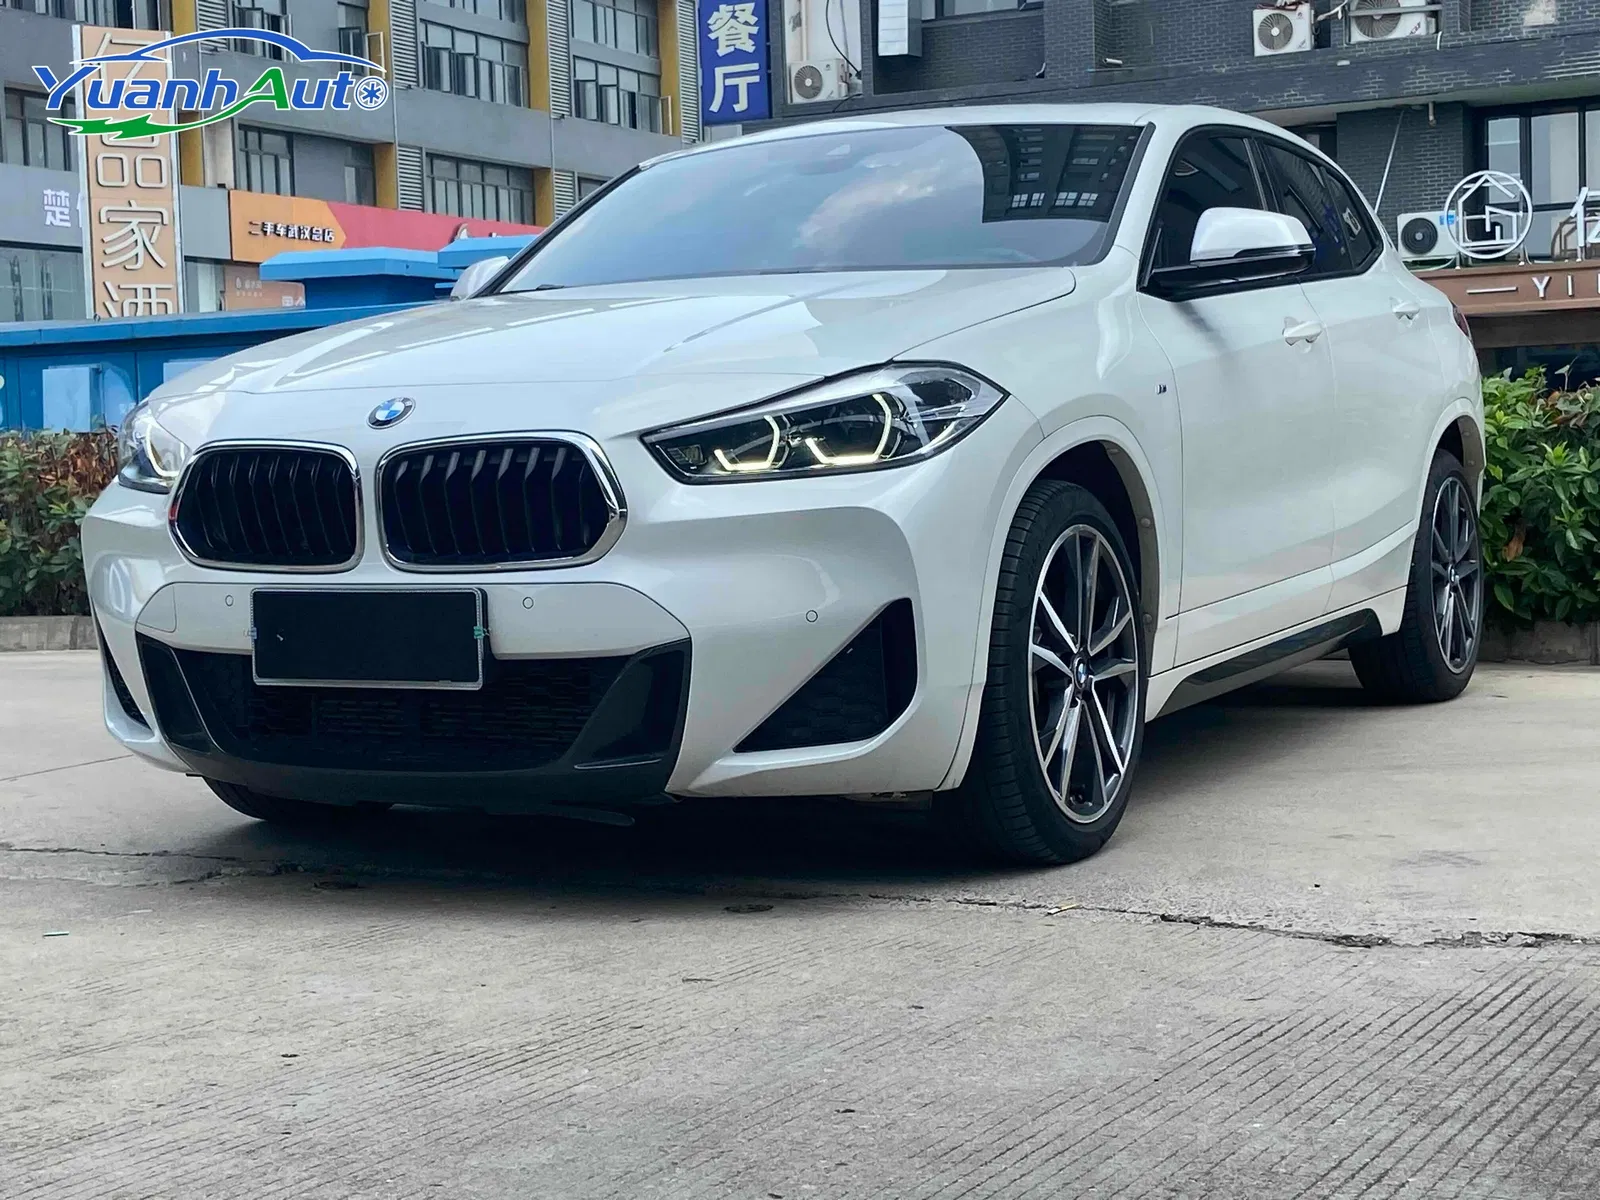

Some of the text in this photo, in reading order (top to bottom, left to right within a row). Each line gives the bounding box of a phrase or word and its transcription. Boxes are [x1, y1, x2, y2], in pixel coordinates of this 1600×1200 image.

[707, 2, 760, 113] 餐厅
[248, 221, 335, 243] 二手车武汉总店
